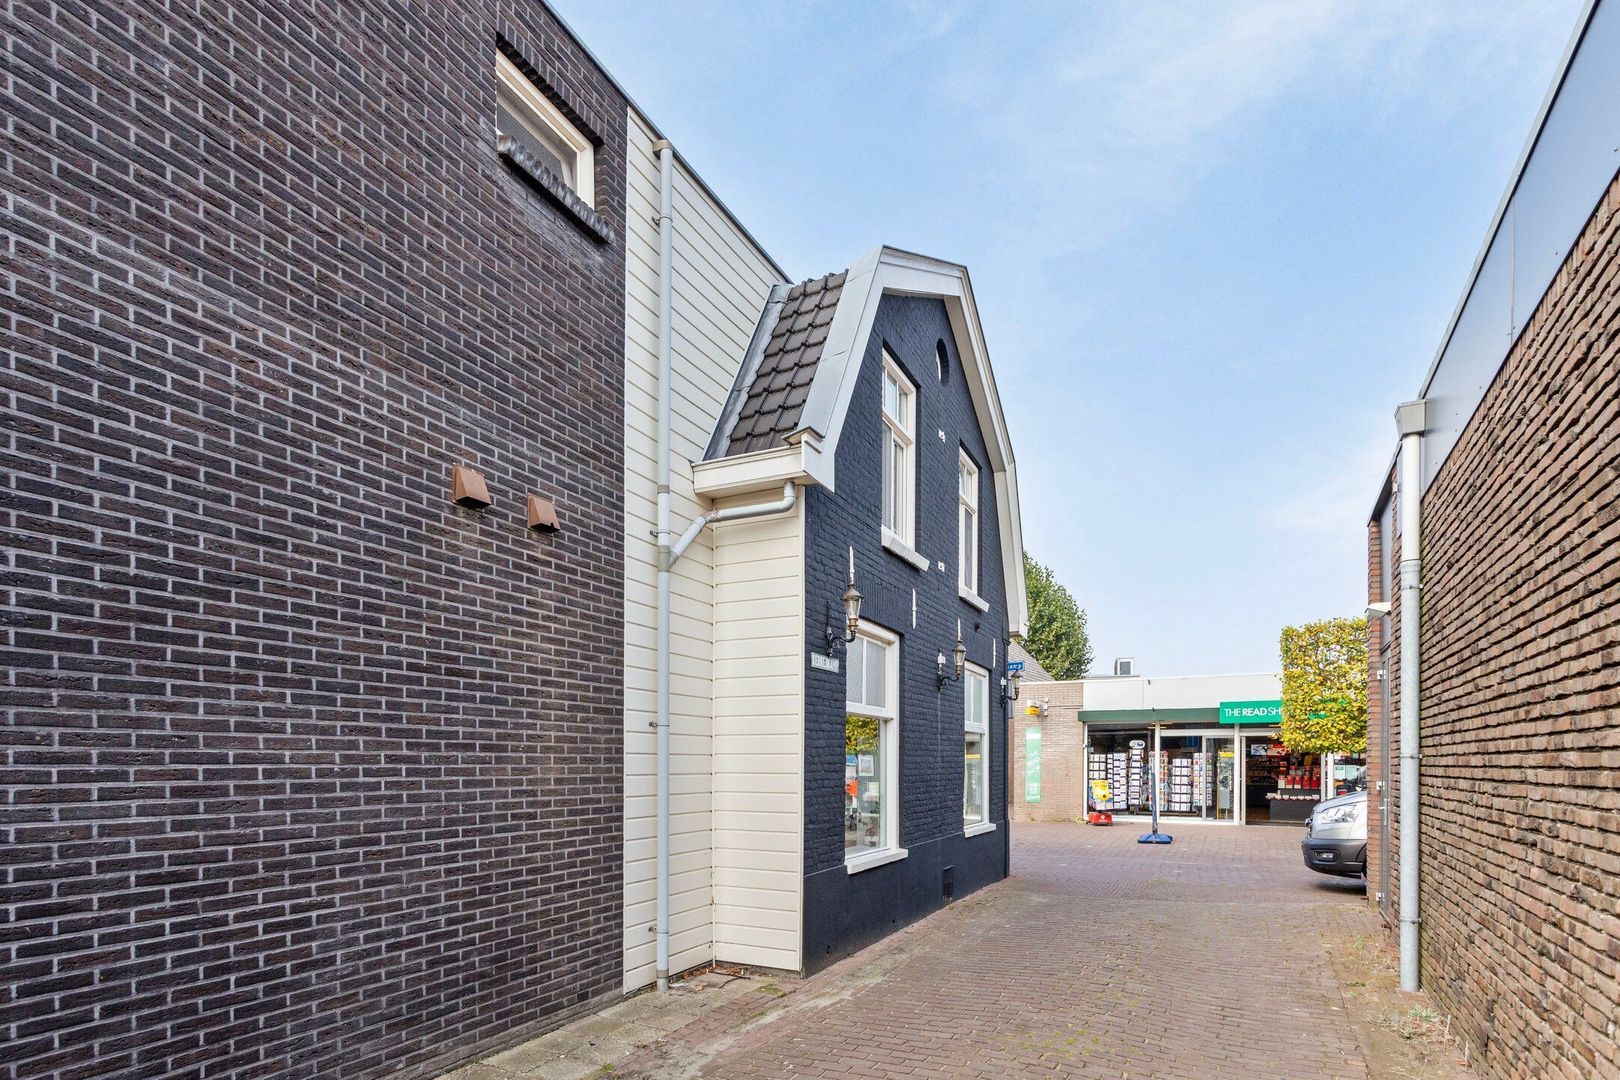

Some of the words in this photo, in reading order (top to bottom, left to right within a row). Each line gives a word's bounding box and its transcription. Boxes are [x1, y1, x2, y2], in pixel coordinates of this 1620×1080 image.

[1224, 708, 1241, 717] THE
[1242, 707, 1267, 717] READ
[1268, 706, 1281, 716] SH
